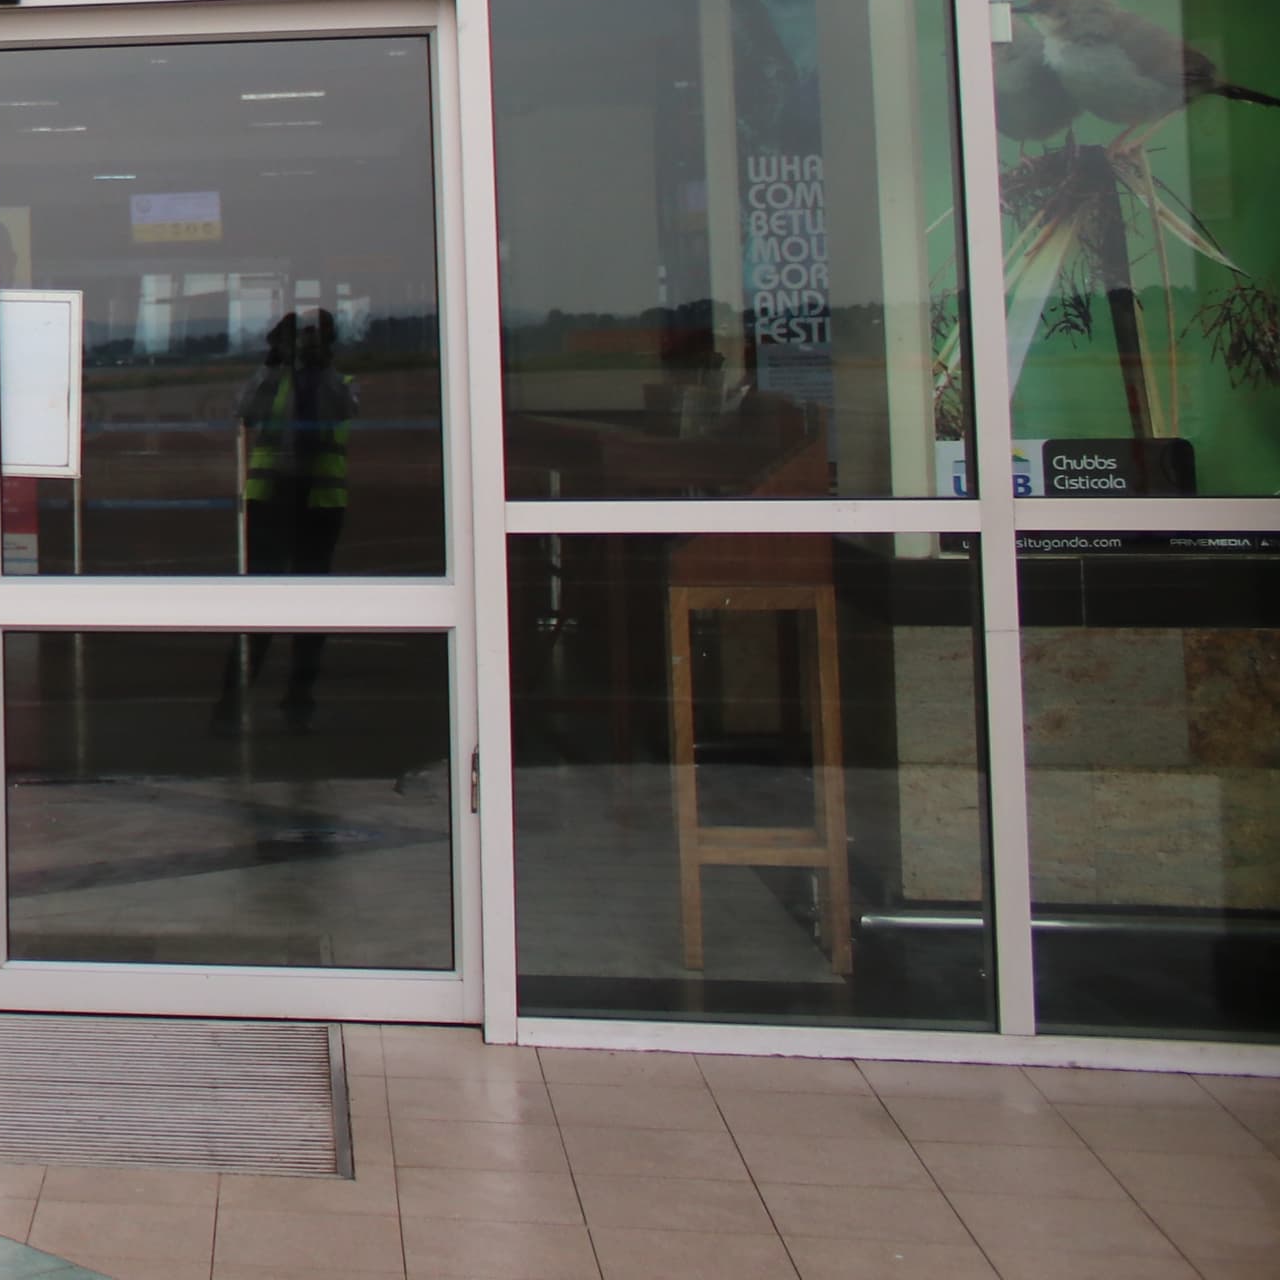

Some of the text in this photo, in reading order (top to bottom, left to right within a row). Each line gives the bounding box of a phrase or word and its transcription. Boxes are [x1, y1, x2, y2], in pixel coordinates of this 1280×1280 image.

[748, 182, 824, 209] COM
[754, 290, 825, 318] AND
[1052, 455, 1118, 471] Chubbs
[1053, 474, 1127, 490] Cisticola
